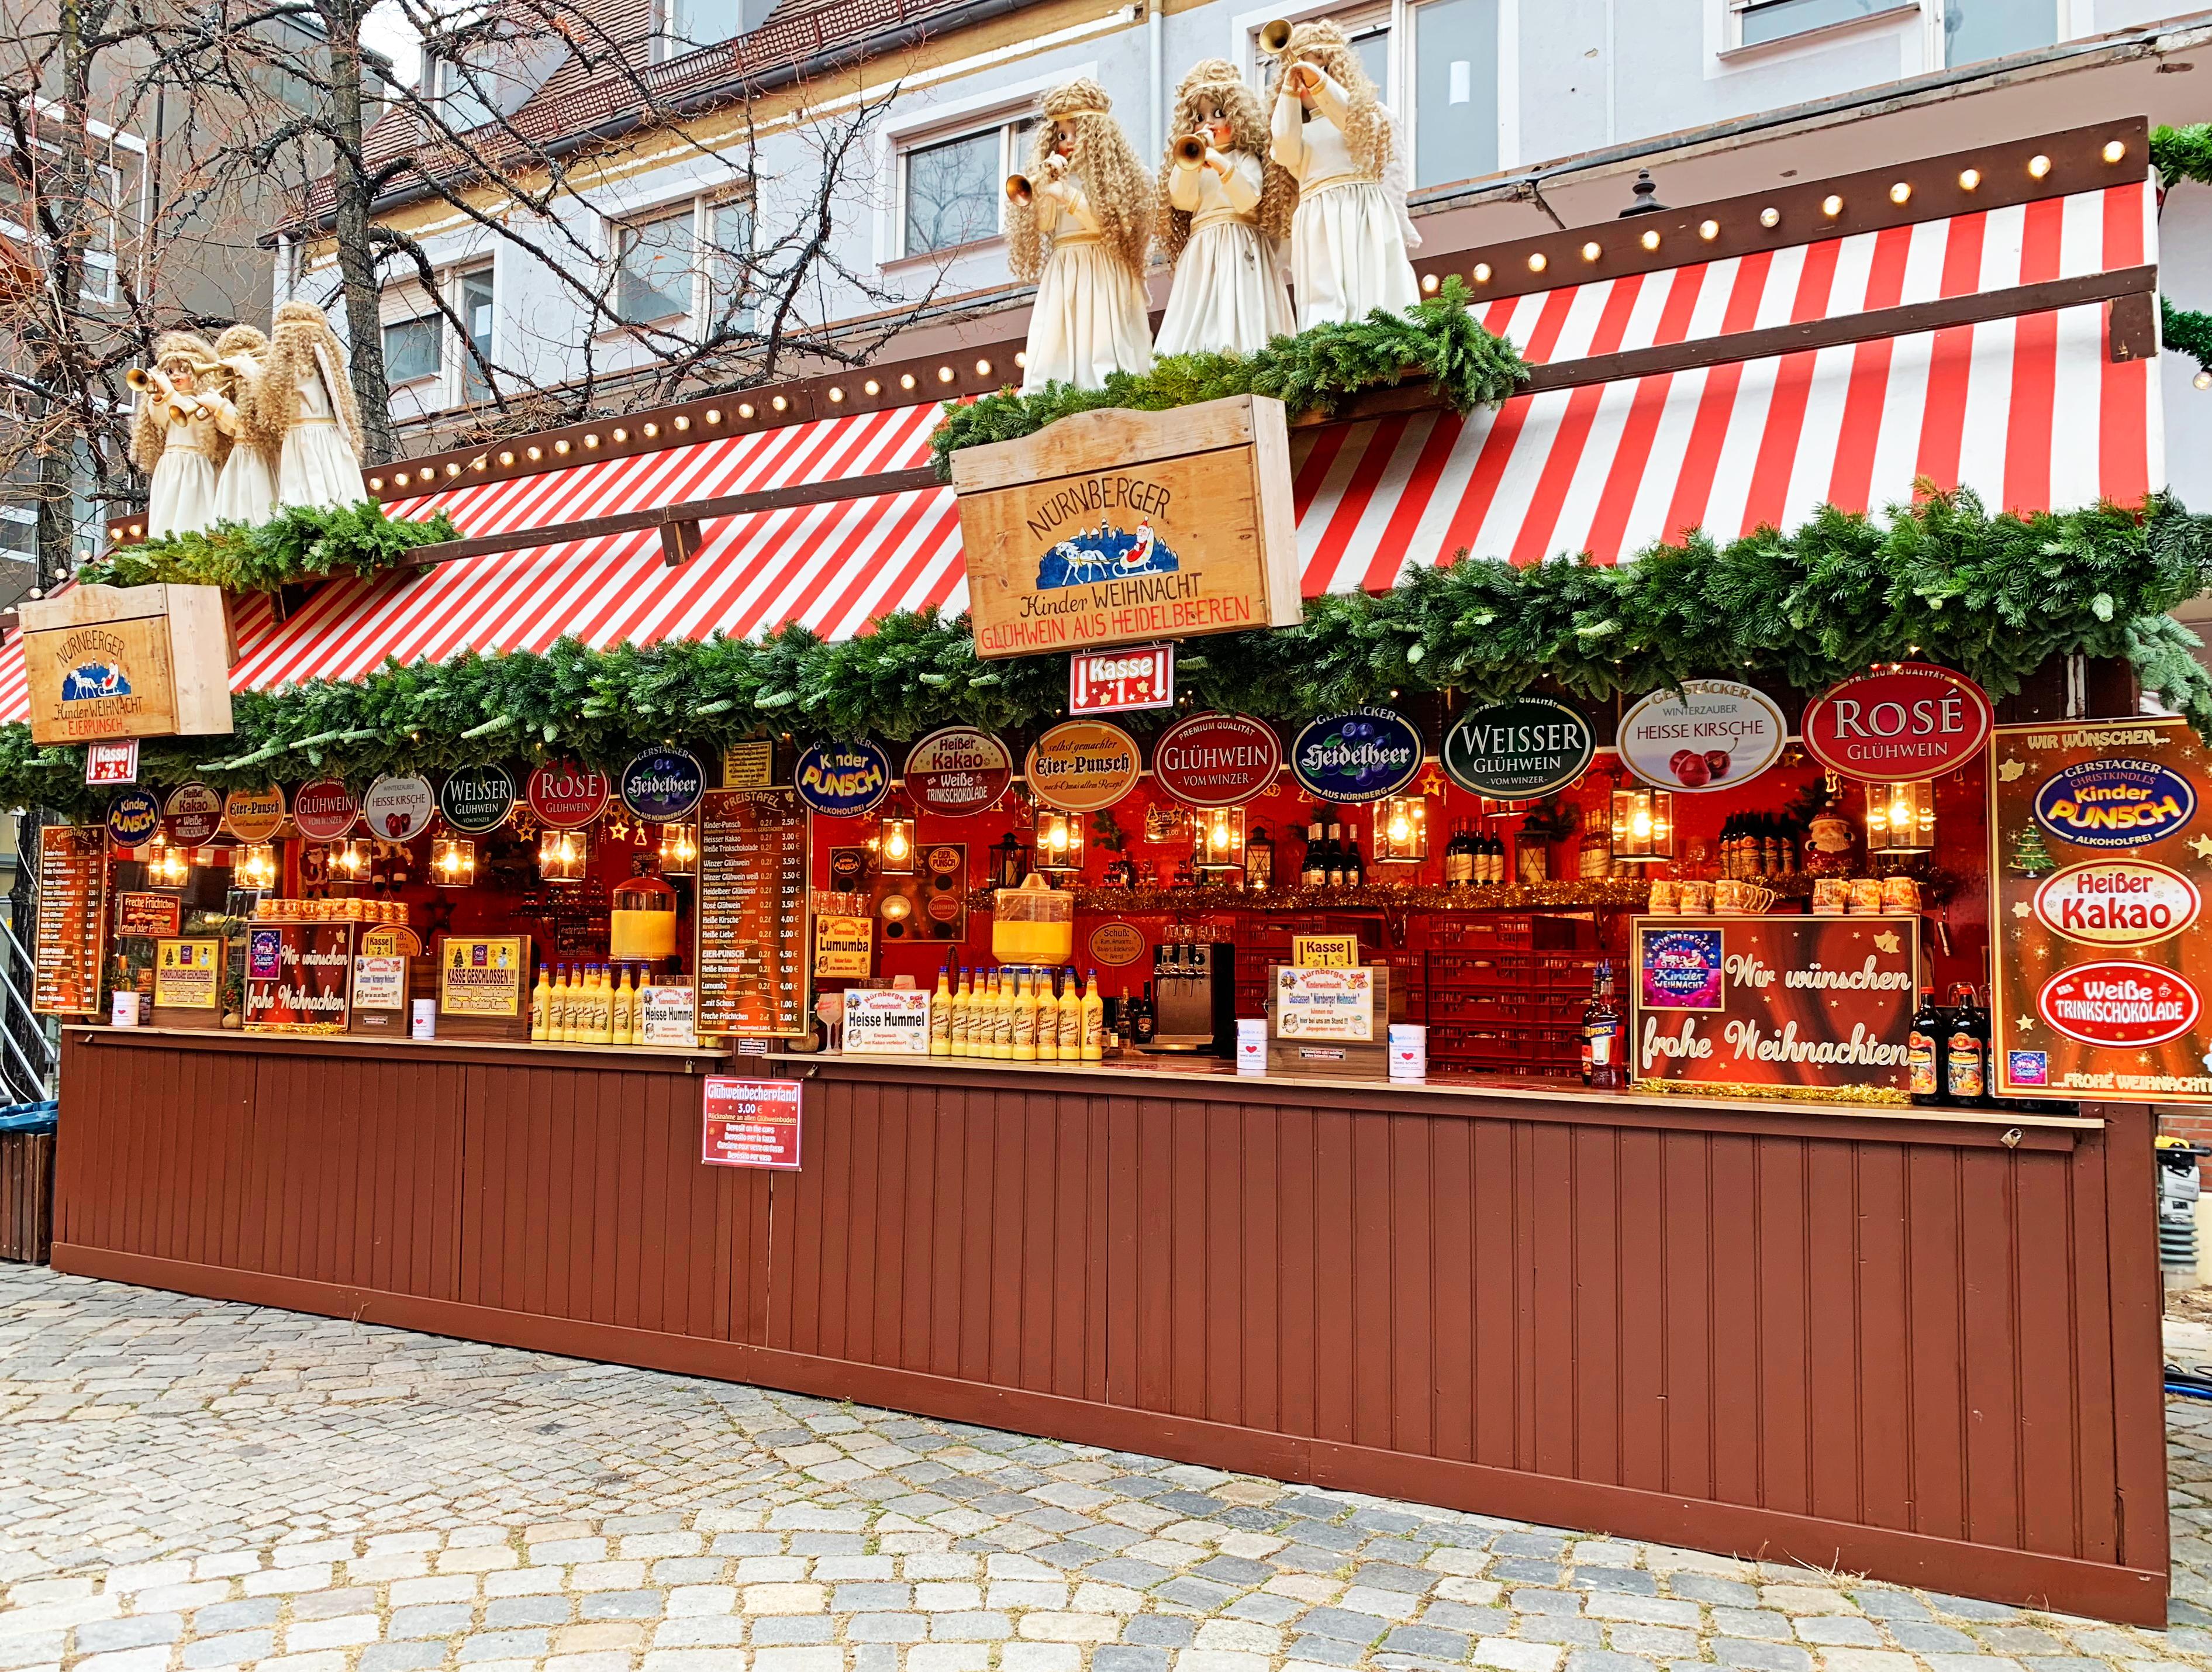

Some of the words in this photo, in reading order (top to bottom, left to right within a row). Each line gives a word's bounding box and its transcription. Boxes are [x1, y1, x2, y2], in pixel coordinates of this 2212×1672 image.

[1027, 477, 1170, 541] NÜRNBERGER
[1020, 591, 1088, 618] Kinder
[1092, 571, 1202, 608] WEIHNACHT
[981, 618, 1065, 650] GLÜHWEIN
[1073, 613, 1106, 639] AUS
[1112, 595, 1250, 634] HEIDELBEEREN
[1089, 656, 1152, 682] Kasse
[1849, 670, 1894, 685] PRMIUM
[1896, 669, 1945, 680] QUALITÄT
[1116, 680, 1124, 704] 1
[52, 703, 88, 720] Kinder
[88, 696, 142, 716] WEIHNACHT
[1519, 697, 1557, 709] QUALITÄT
[1663, 705, 1737, 716] WINTERZAUBER
[1833, 688, 1963, 739] ROSÉ
[68, 718, 122, 735] EIERPUNSCH
[1179, 722, 1214, 740] PREMIUM
[1217, 722, 1255, 736] QUALITÄT
[1638, 724, 1689, 740] HEISSE
[1695, 720, 1764, 737] KIRSCHE
[940, 739, 975, 751] Heißer
[1461, 724, 1582, 755] WEISSER
[2028, 735, 2058, 749] WIR
[97, 746, 127, 762] Kasse
[1165, 745, 1268, 770] GLÜHWEIN
[1302, 743, 1410, 771] Heidelbeer
[1847, 742, 1948, 760] GLÜHWEIN
[820, 754, 868, 769] Knder
[933, 751, 983, 770] Kakao
[1036, 753, 1129, 777] Eier-Punsch
[1473, 756, 1561, 773] GLÜHWEIN
[108, 763, 115, 778] 2
[627, 775, 697, 797] Heidelbeer
[802, 765, 882, 797] PUNSCH
[941, 773, 973, 787] Weiße
[2070, 772, 2156, 787] CHRISTKINDLES
[184, 790, 204, 798] Heißer
[372, 797, 395, 806] HEISSE
[396, 794, 426, 805] KIRSCHE
[450, 781, 508, 802] WEISSER
[926, 786, 987, 803] TRINKSCHOKOLADE
[1322, 790, 1338, 799] AUS
[1340, 787, 1387, 801] NÜRNBERG
[2074, 784, 2152, 804] Kinder
[121, 798, 148, 812] Kinder
[180, 799, 208, 812] Kakao
[230, 801, 279, 815] Eier-Punsch
[299, 796, 353, 814] GLÜHWEIN
[455, 802, 498, 814] GLÜHWEIN
[546, 801, 590, 813] GLÜHWEIN
[723, 792, 779, 810] PREISTAFEL
[651, 811, 682, 821] NÜRNBERG
[819, 805, 864, 815] ALKOHOLFREI
[2047, 795, 2182, 829] PUNSCH
[111, 808, 156, 832] PUNSCH
[184, 817, 202, 825] Weiße
[2075, 833, 2152, 846] ALKOHOLFREI
[933, 859, 955, 867] PUNSCH
[2078, 873, 2154, 893] Heißer
[126, 897, 144, 908] Freche
[2062, 897, 2171, 929] Kakao
[370, 937, 389, 946] Kasse
[820, 937, 868, 952] Lumumba
[1307, 942, 1344, 953] Kasse
[281, 945, 299, 965] Wir
[302, 944, 347, 965] wünschen
[448, 969, 465, 983] KASSE
[468, 969, 508, 984] GESCHLOSSEN
[1300, 968, 1347, 982] Nürnberger
[1654, 969, 1705, 980] Kinder
[1726, 954, 1775, 988] Wir
[1786, 955, 1911, 991] wünschen
[864, 991, 906, 1003] Nürnberger
[2084, 980, 2152, 1001] Weiße
[247, 984, 274, 1016] frohe
[278, 984, 345, 1011] Weihnachten
[646, 1008, 667, 1021] Heisse
[850, 1012, 881, 1026] Heisse
[885, 1012, 924, 1026] Hummel
[2055, 1000, 2184, 1023] TRINKSCHOKOLADE
[1642, 1016, 1713, 1069] frohe
[1724, 1019, 1910, 1066] Weihnachten
[708, 1084, 797, 1102] Glühweinbecherpfand
[738, 1104, 755, 1113] 3.00
[757, 1105, 762, 1113] €
